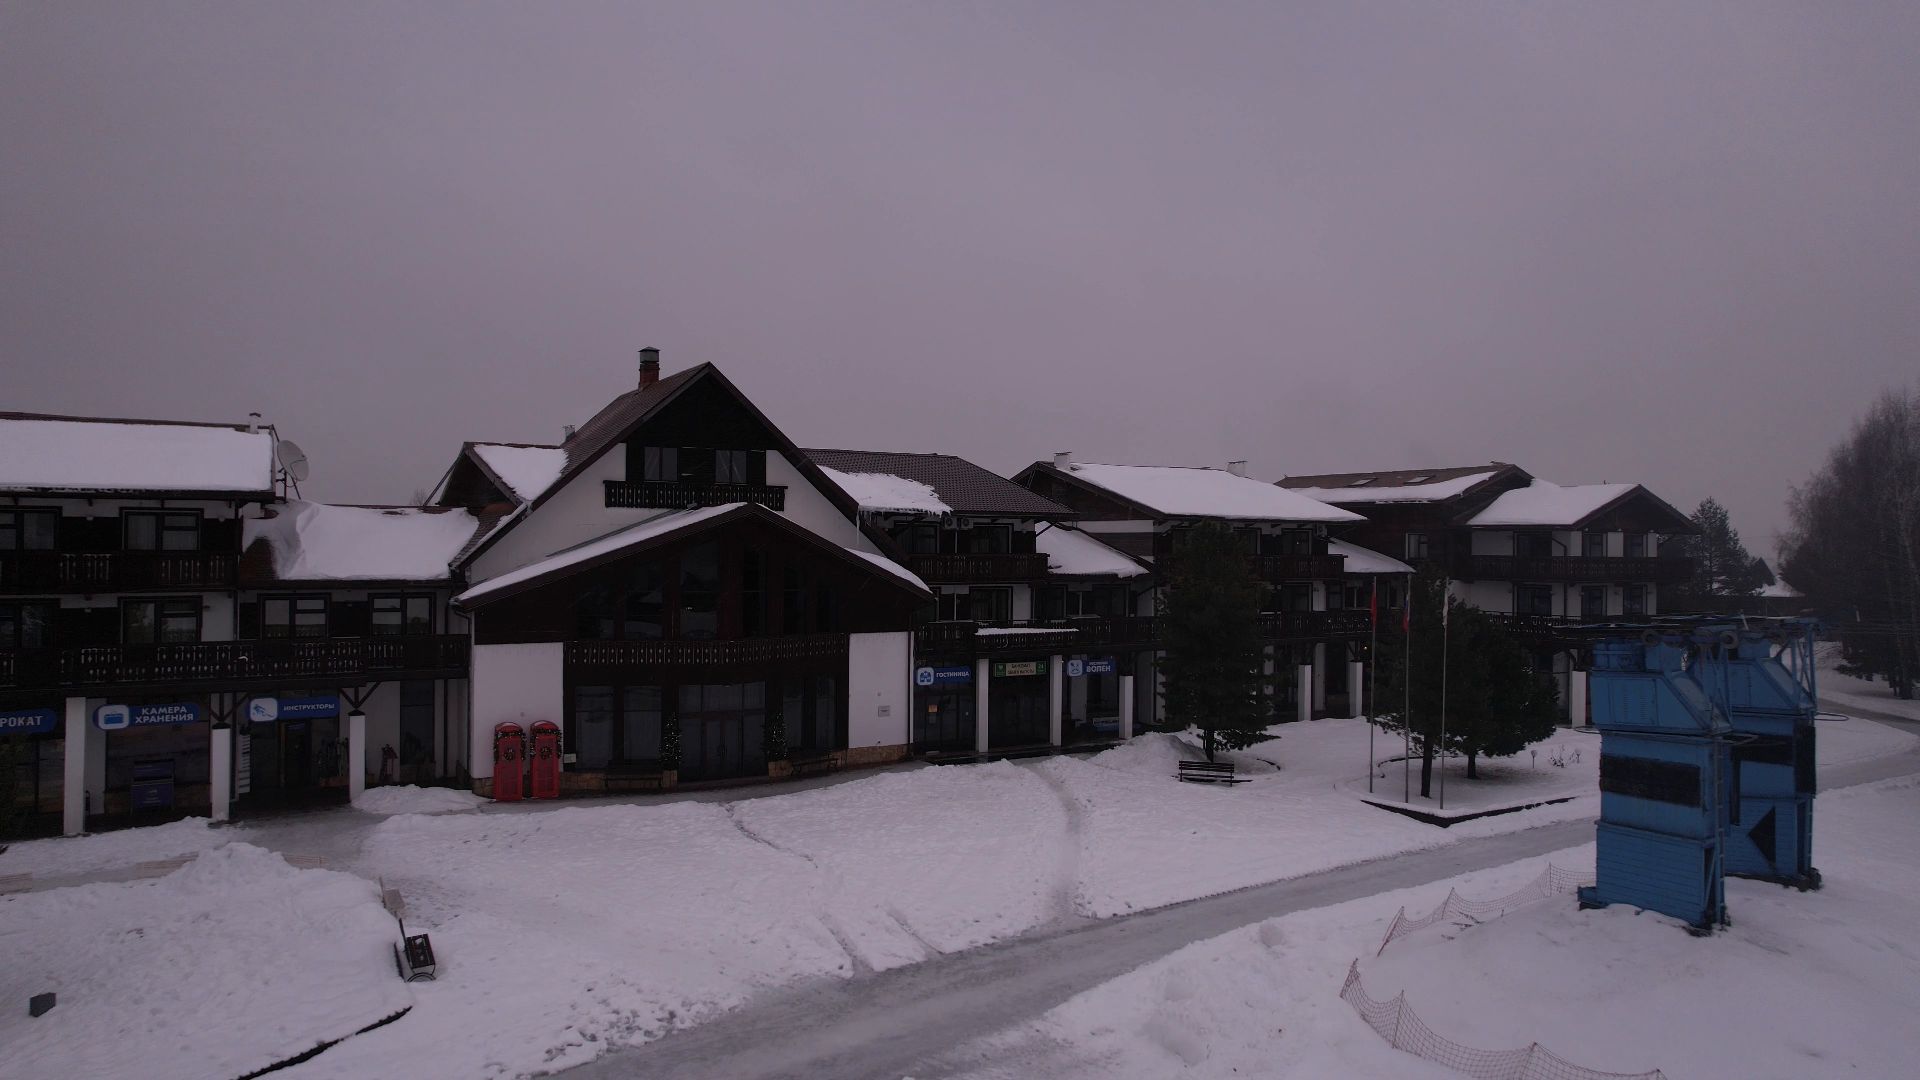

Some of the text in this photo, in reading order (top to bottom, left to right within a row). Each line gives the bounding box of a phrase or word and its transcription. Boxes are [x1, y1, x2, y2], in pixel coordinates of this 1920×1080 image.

[936, 671, 970, 679] ГОСТИНИЦА
[141, 705, 188, 716] КАМЕРА
[283, 703, 335, 712] ИНСТРУКТОРЫ
[135, 713, 194, 724] ХРАНЕНИЯ
